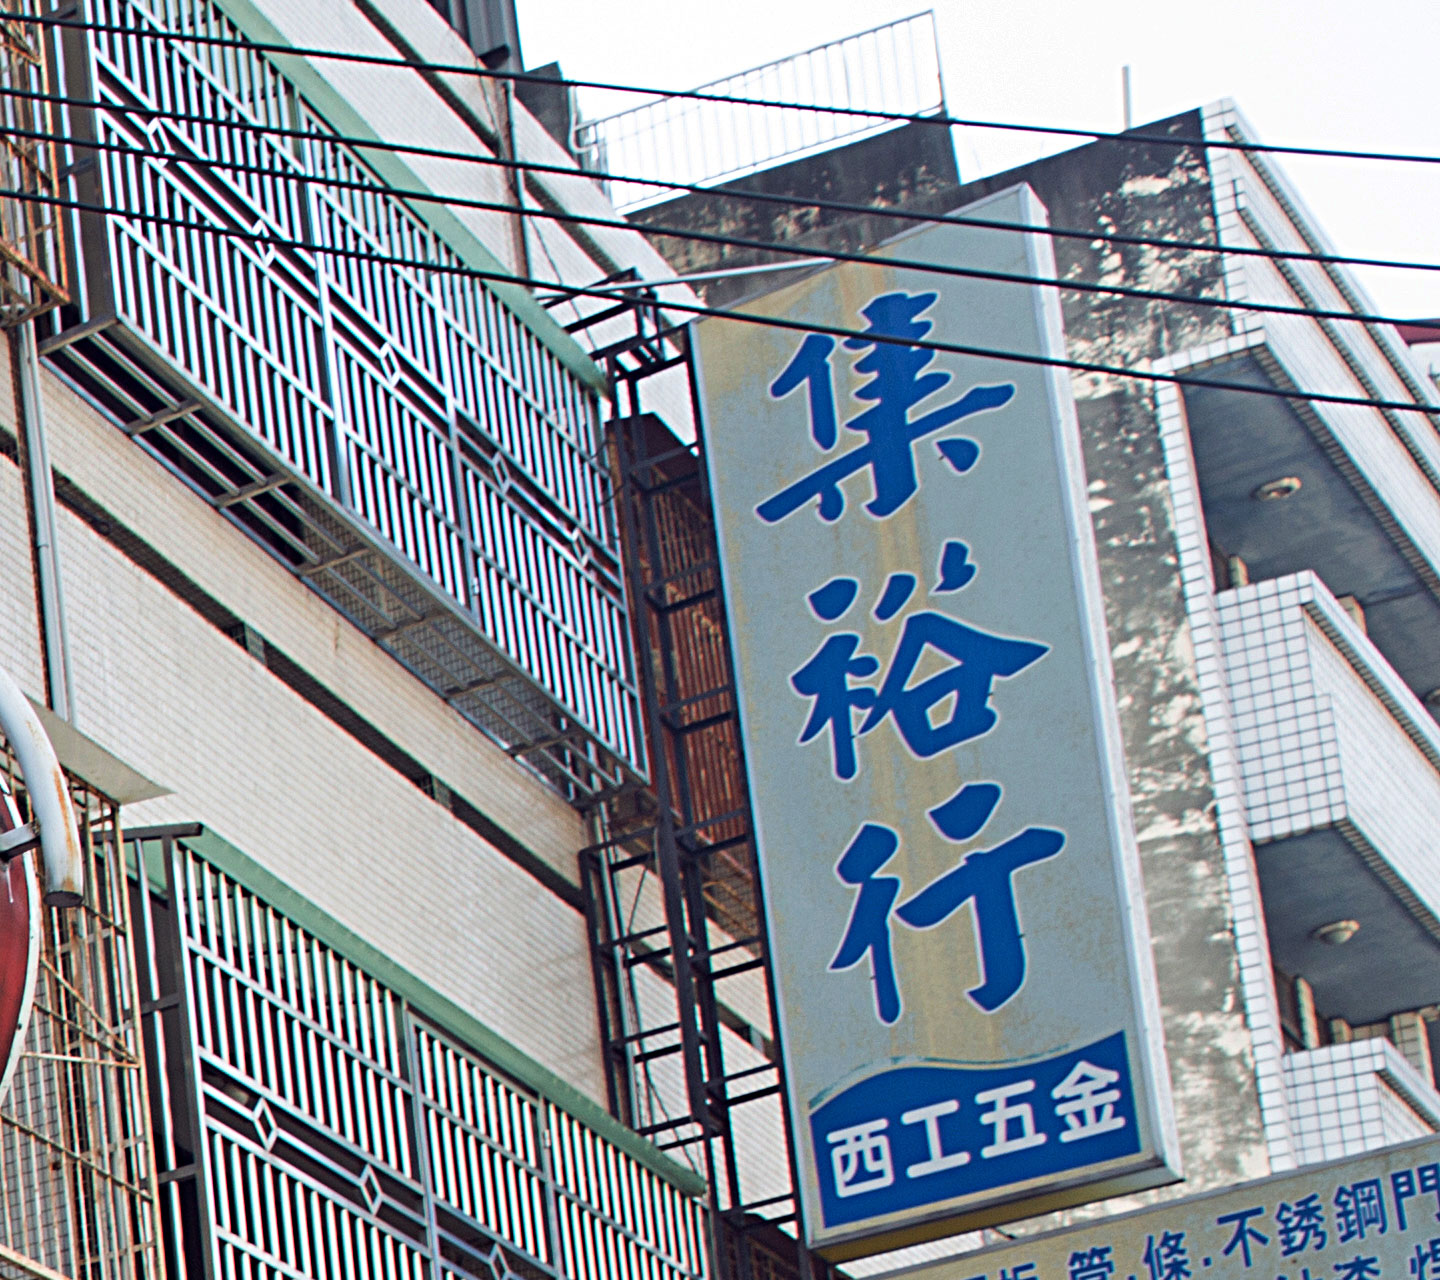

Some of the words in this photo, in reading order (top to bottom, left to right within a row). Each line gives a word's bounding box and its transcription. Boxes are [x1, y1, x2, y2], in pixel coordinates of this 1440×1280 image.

[755, 288, 1067, 1026] 集裕行
[826, 1059, 1126, 1198] 西工五金
